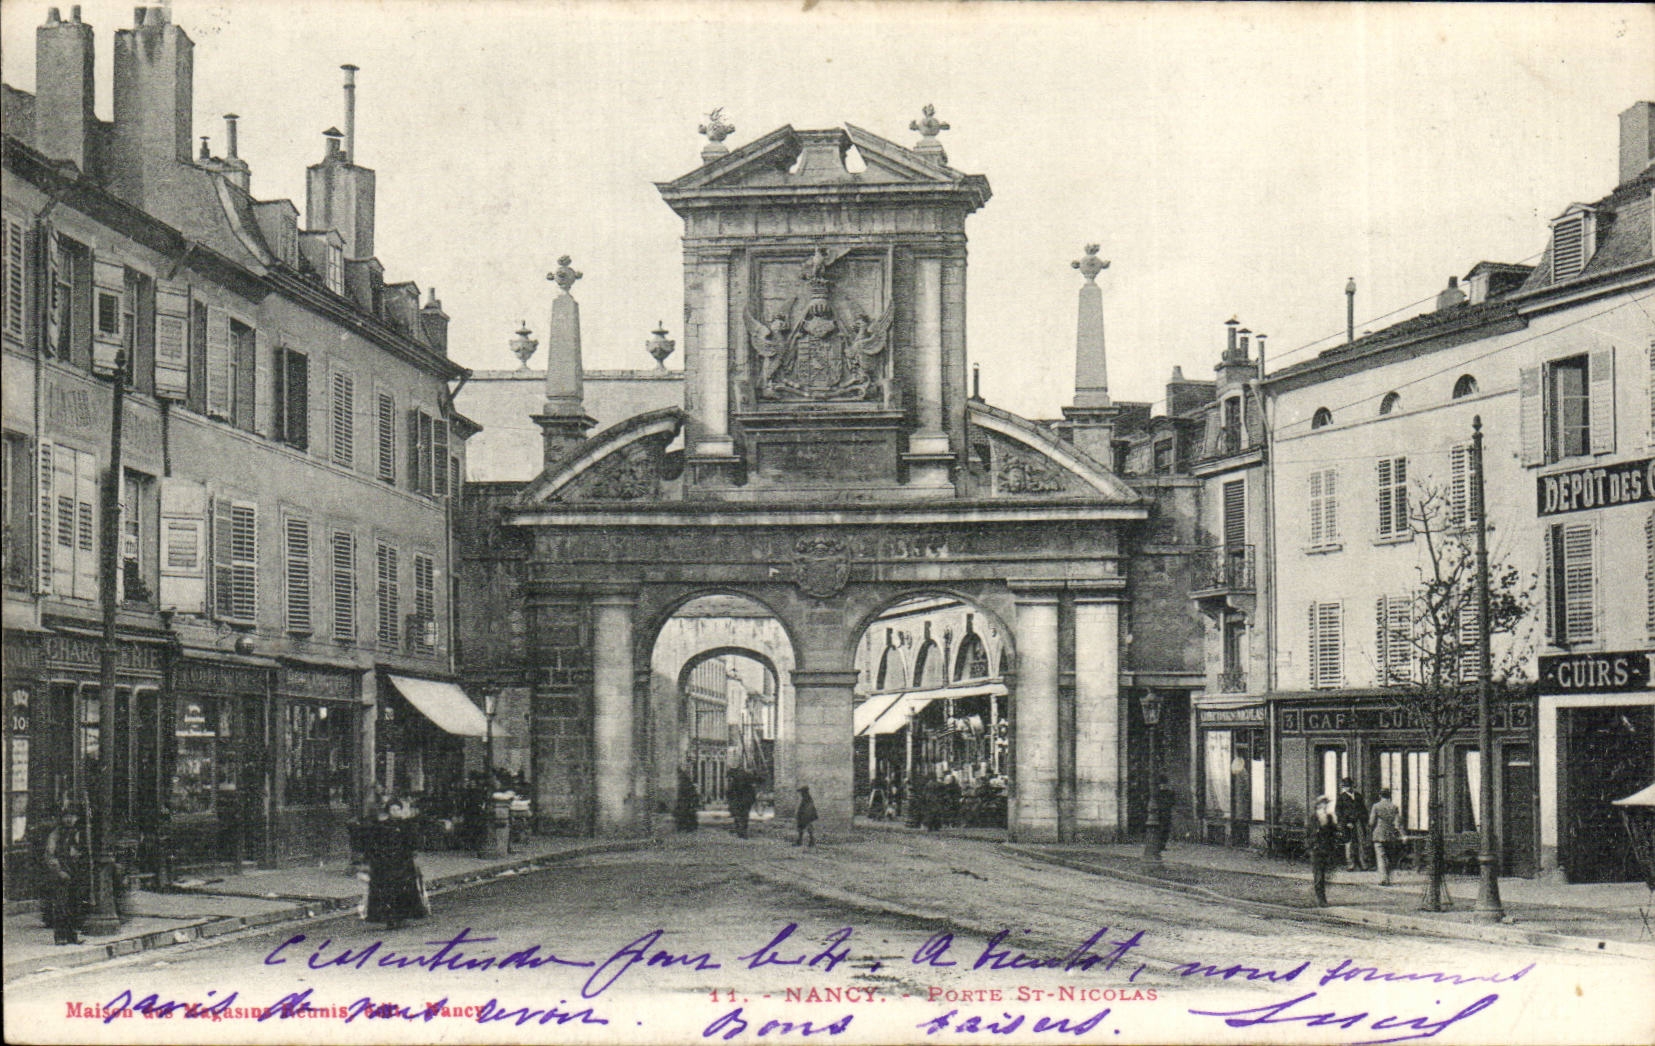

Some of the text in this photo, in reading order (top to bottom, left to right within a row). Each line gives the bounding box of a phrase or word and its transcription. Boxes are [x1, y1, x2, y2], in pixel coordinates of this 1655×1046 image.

[1543, 468, 1607, 513] DÉPÔT
[1609, 469, 1642, 504] DES
[47, 637, 162, 669] CHARCERIE
[13, 716, 26, 730] 10
[1285, 714, 1294, 730] 3
[1308, 713, 1358, 730] CAF
[1516, 708, 1527, 726] 3
[581, 929, 721, 999] pour
[1171, 960, 1311, 984] nous
